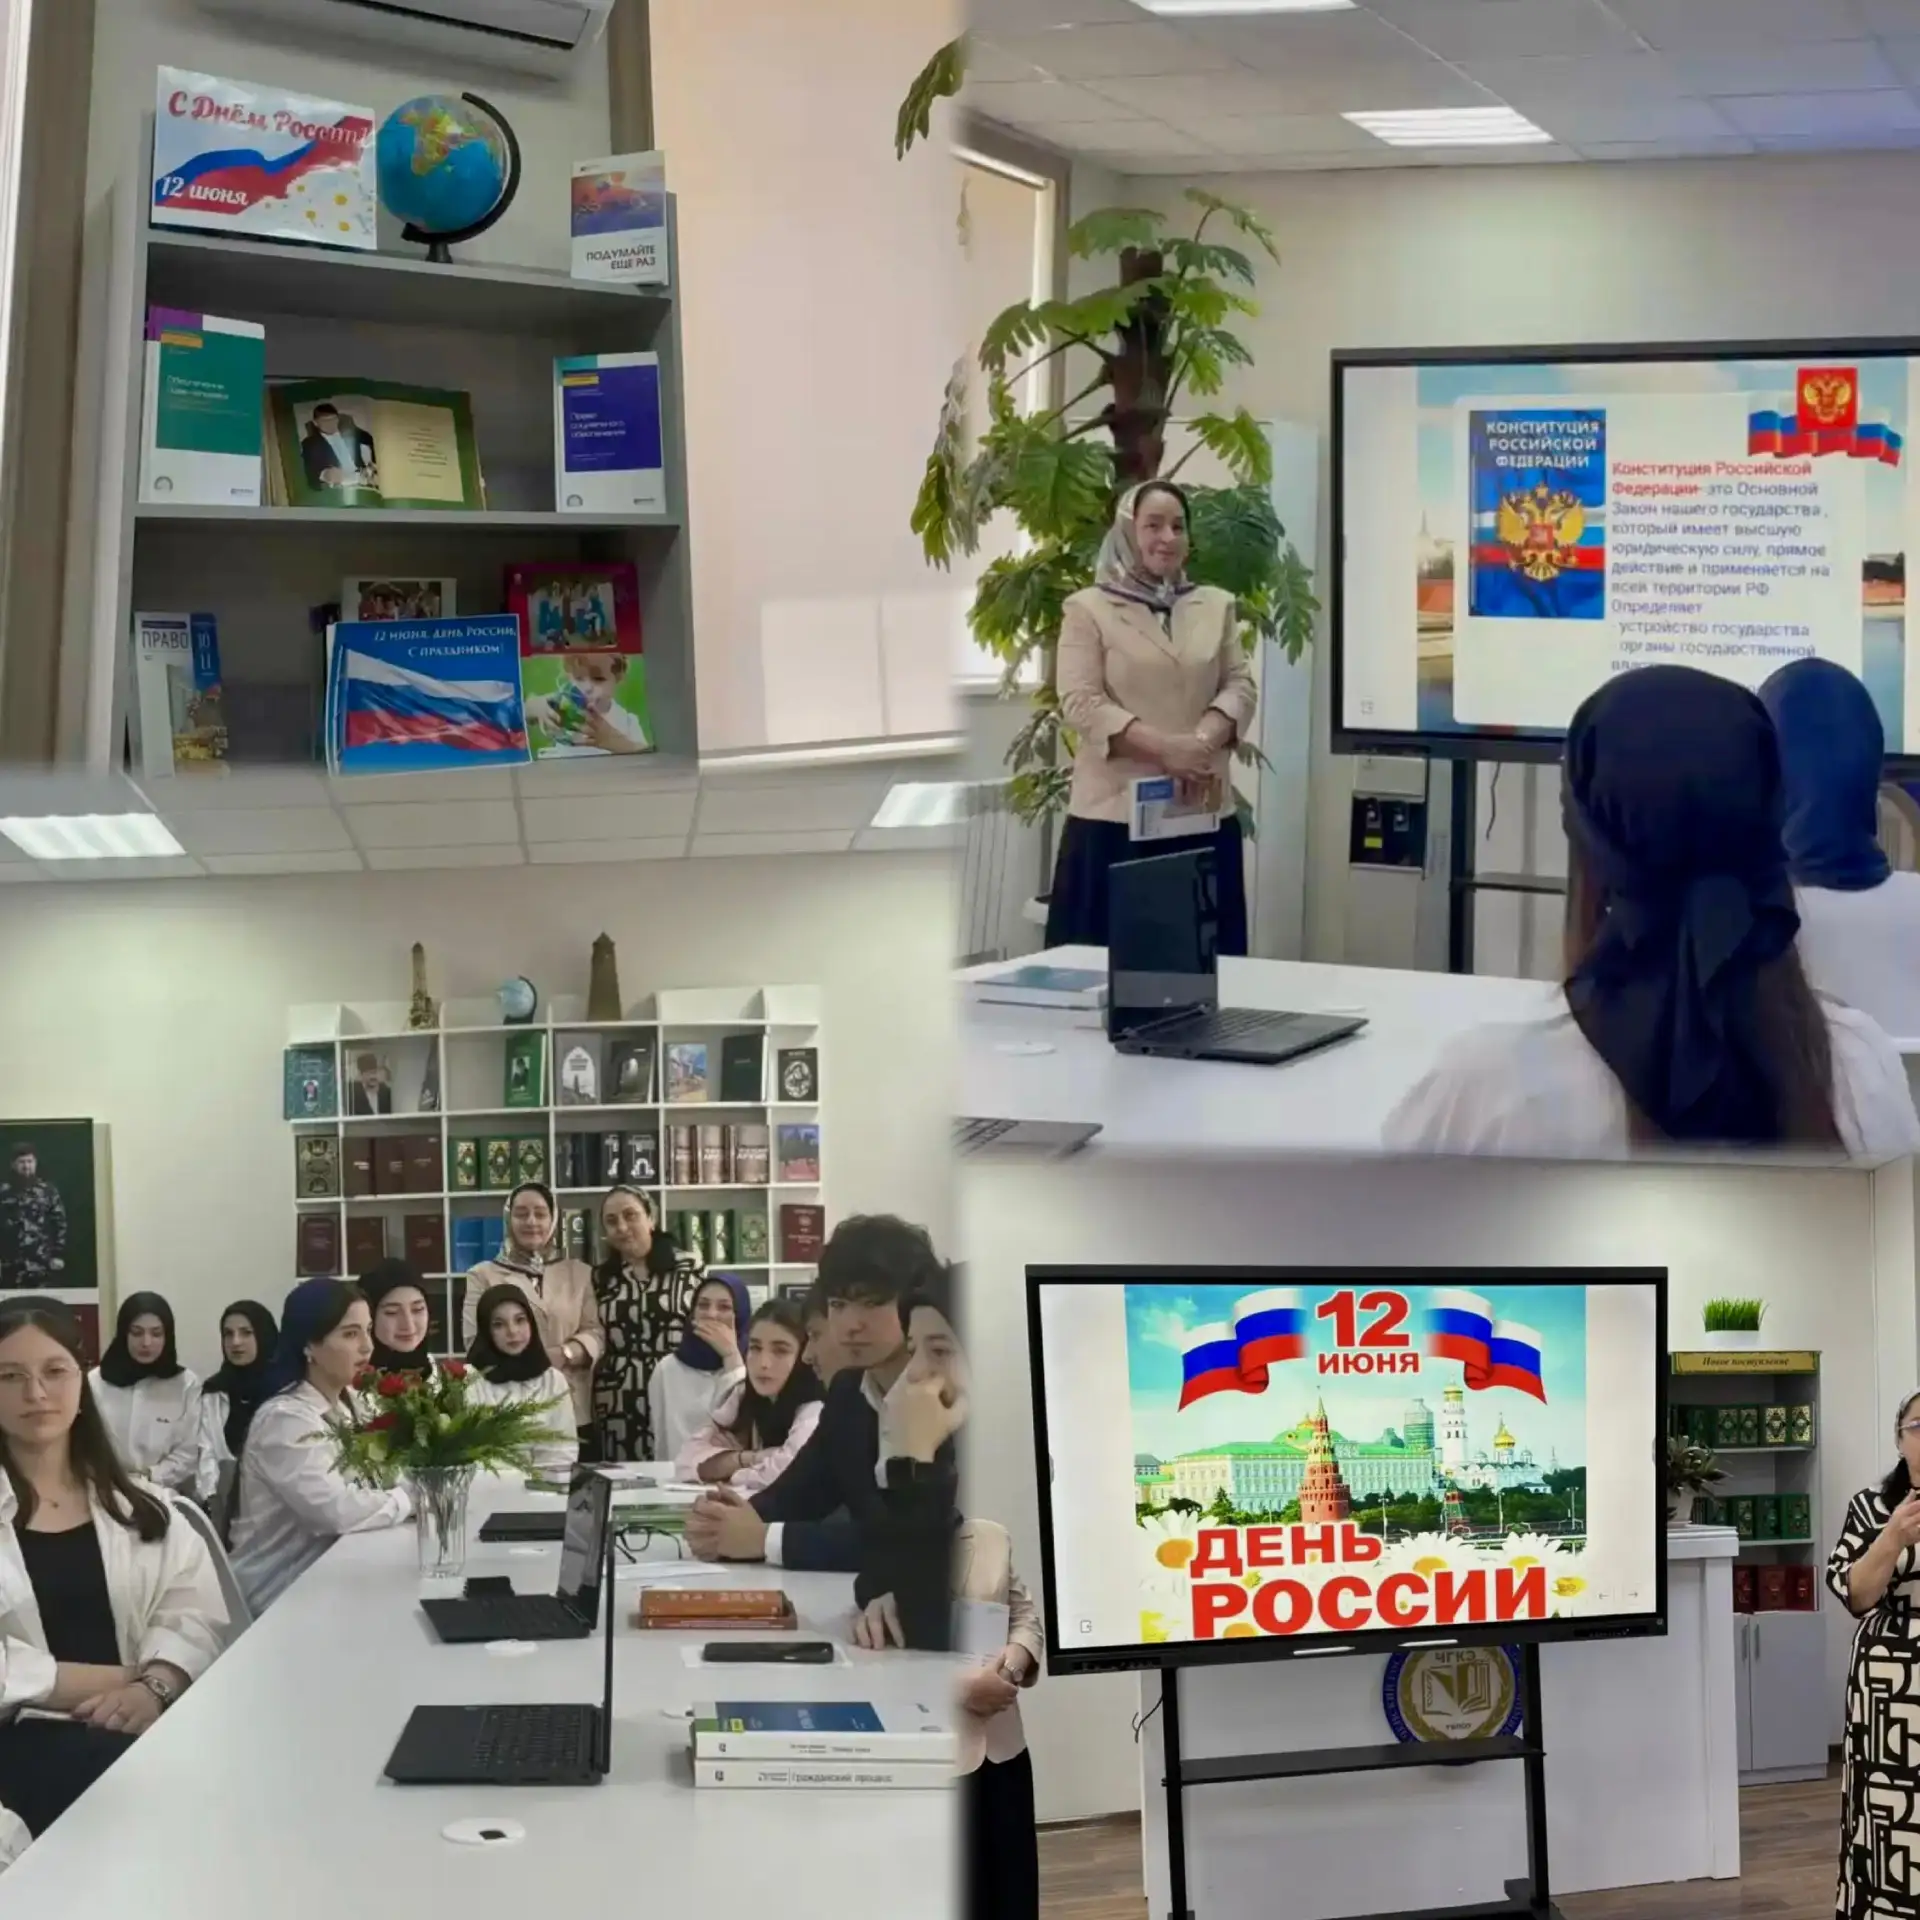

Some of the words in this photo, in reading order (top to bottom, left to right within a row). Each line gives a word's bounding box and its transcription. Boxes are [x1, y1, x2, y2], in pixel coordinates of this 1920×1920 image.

[168, 90, 187, 117] С
[190, 95, 268, 131] Днём
[161, 176, 184, 197] 12
[189, 185, 249, 206] июня
[586, 244, 656, 262] ПОДУМАЙТЕ
[610, 259, 634, 270] ЕЩЕ
[635, 257, 656, 268] РАЗ
[1486, 421, 1600, 434] КОНСТИТУЦИЯ
[1489, 436, 1597, 451] РОССИЙСКОЙ
[1495, 455, 1590, 469] ФЕДЕРАЦИИ
[1612, 462, 1711, 477] Конституция
[1716, 462, 1812, 476] Российской
[1707, 484, 1733, 495] это
[1737, 482, 1819, 496] Основной
[1612, 502, 1657, 515] Закон
[1662, 505, 1719, 515] нашего
[1612, 522, 1678, 537] который
[1682, 525, 1729, 535] имеет
[1735, 525, 1803, 537] высшую
[1612, 545, 1720, 559] юридическую
[1766, 545, 1827, 558] прямое
[1611, 563, 1684, 577] действие
[1688, 565, 1697, 575] и
[1702, 565, 1806, 578] применяется
[1811, 567, 1830, 577] на
[1611, 582, 1647, 594] всей
[1652, 584, 1741, 597] территории
[1746, 582, 1770, 596] РФ
[1611, 599, 1703, 615] Определяет
[373, 631, 386, 642] 12
[1619, 620, 1709, 636] устройство
[1712, 623, 1810, 638] государства
[142, 631, 190, 650] ПРАВО
[1619, 642, 1676, 655] органы
[1679, 643, 1816, 657] государственной
[1317, 1290, 1411, 1348] 12
[1318, 1352, 1420, 1375] ИЮНЯ
[1190, 1523, 1383, 1579] ДЕНЬ
[1191, 1566, 1547, 1640] РОССИИ
